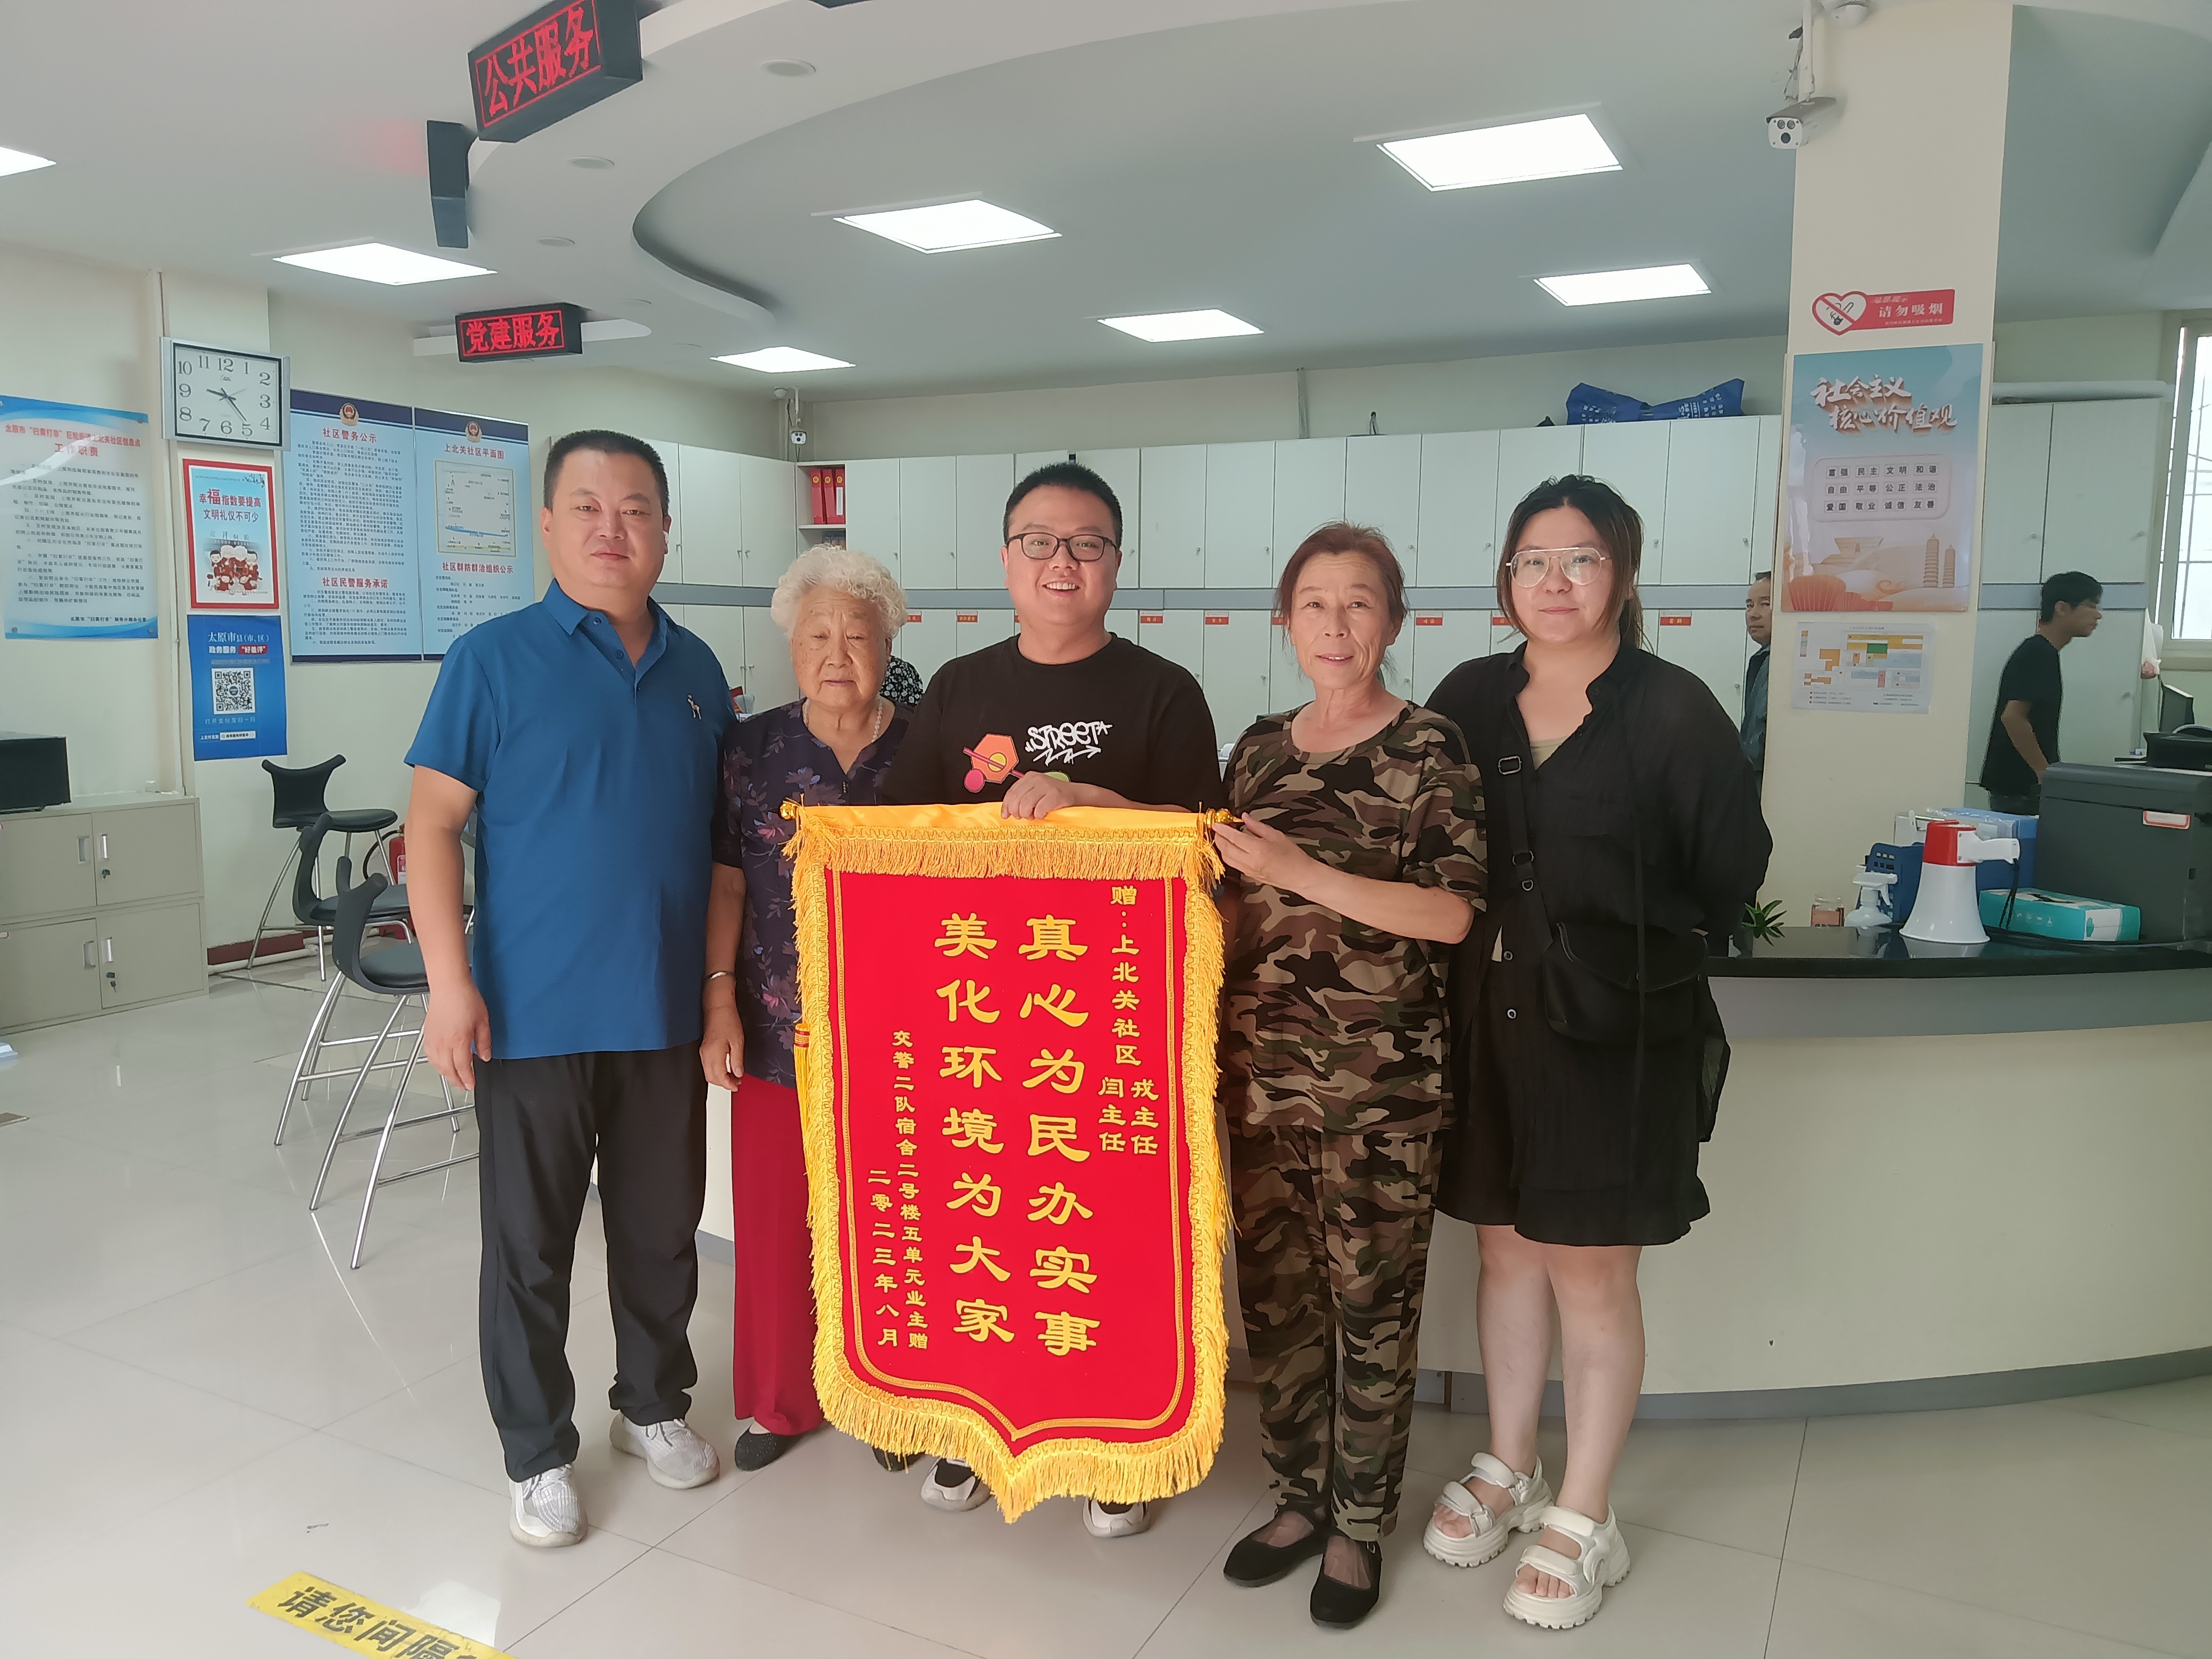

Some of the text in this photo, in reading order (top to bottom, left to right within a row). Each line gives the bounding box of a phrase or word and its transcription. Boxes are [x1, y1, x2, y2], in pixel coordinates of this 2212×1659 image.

[484, 6, 593, 117] 公共服务
[1879, 303, 1943, 317] 请勿吸烟
[465, 313, 559, 353] 党建服务
[178, 361, 192, 375] 10
[198, 355, 210, 369] 11
[217, 357, 234, 372] 12
[244, 362, 249, 374] 1
[259, 372, 271, 386] 2
[179, 383, 191, 397] 9
[1810, 374, 1912, 407] 社会主义
[259, 394, 271, 408] 3
[179, 407, 192, 421] 8
[1829, 403, 1958, 432] 核心价值观
[199, 418, 211, 431] 7
[220, 421, 232, 434] 6
[241, 423, 253, 437] 5
[259, 417, 271, 430] 4
[322, 428, 378, 443] 社区警务公示
[444, 443, 505, 459] 上北关社区平面图
[198, 488, 262, 508] 幸福指数要提高
[203, 508, 259, 523] 文明礼仪不可少
[442, 562, 514, 574] 社区群防群治组织公示
[322, 577, 389, 589] 社区民警服务承诺
[1027, 721, 1100, 751] STREET
[1098, 1076, 1126, 1152] 闫主任
[1130, 1078, 1159, 1155] 戎主任
[934, 912, 1015, 1343] 美化环境为大家
[1018, 914, 1100, 1356] 真心为民办实事
[892, 1030, 928, 1350] 交警二队宿舍二号楼五单元业主赠
[868, 1169, 899, 1347] 二零二三年八月
[277, 1586, 477, 1659] 请您间隔
